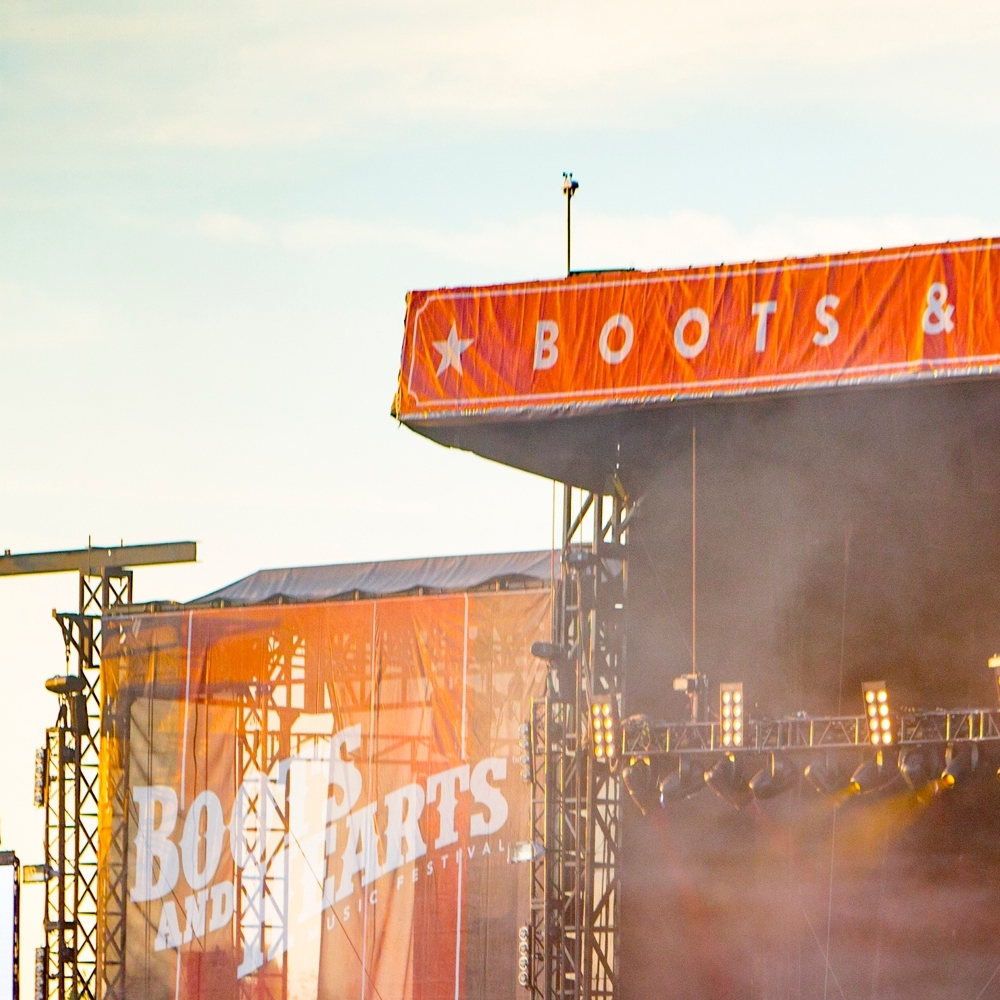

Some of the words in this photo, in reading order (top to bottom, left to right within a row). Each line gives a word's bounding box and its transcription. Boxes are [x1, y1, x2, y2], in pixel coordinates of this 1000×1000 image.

[533, 294, 840, 371] BOOTS
[921, 282, 955, 335] &
[130, 723, 362, 903] BOOTS
[236, 757, 509, 980] HEARTS
[396, 839, 505, 890] FESTIVAL
[154, 880, 236, 952] AND
